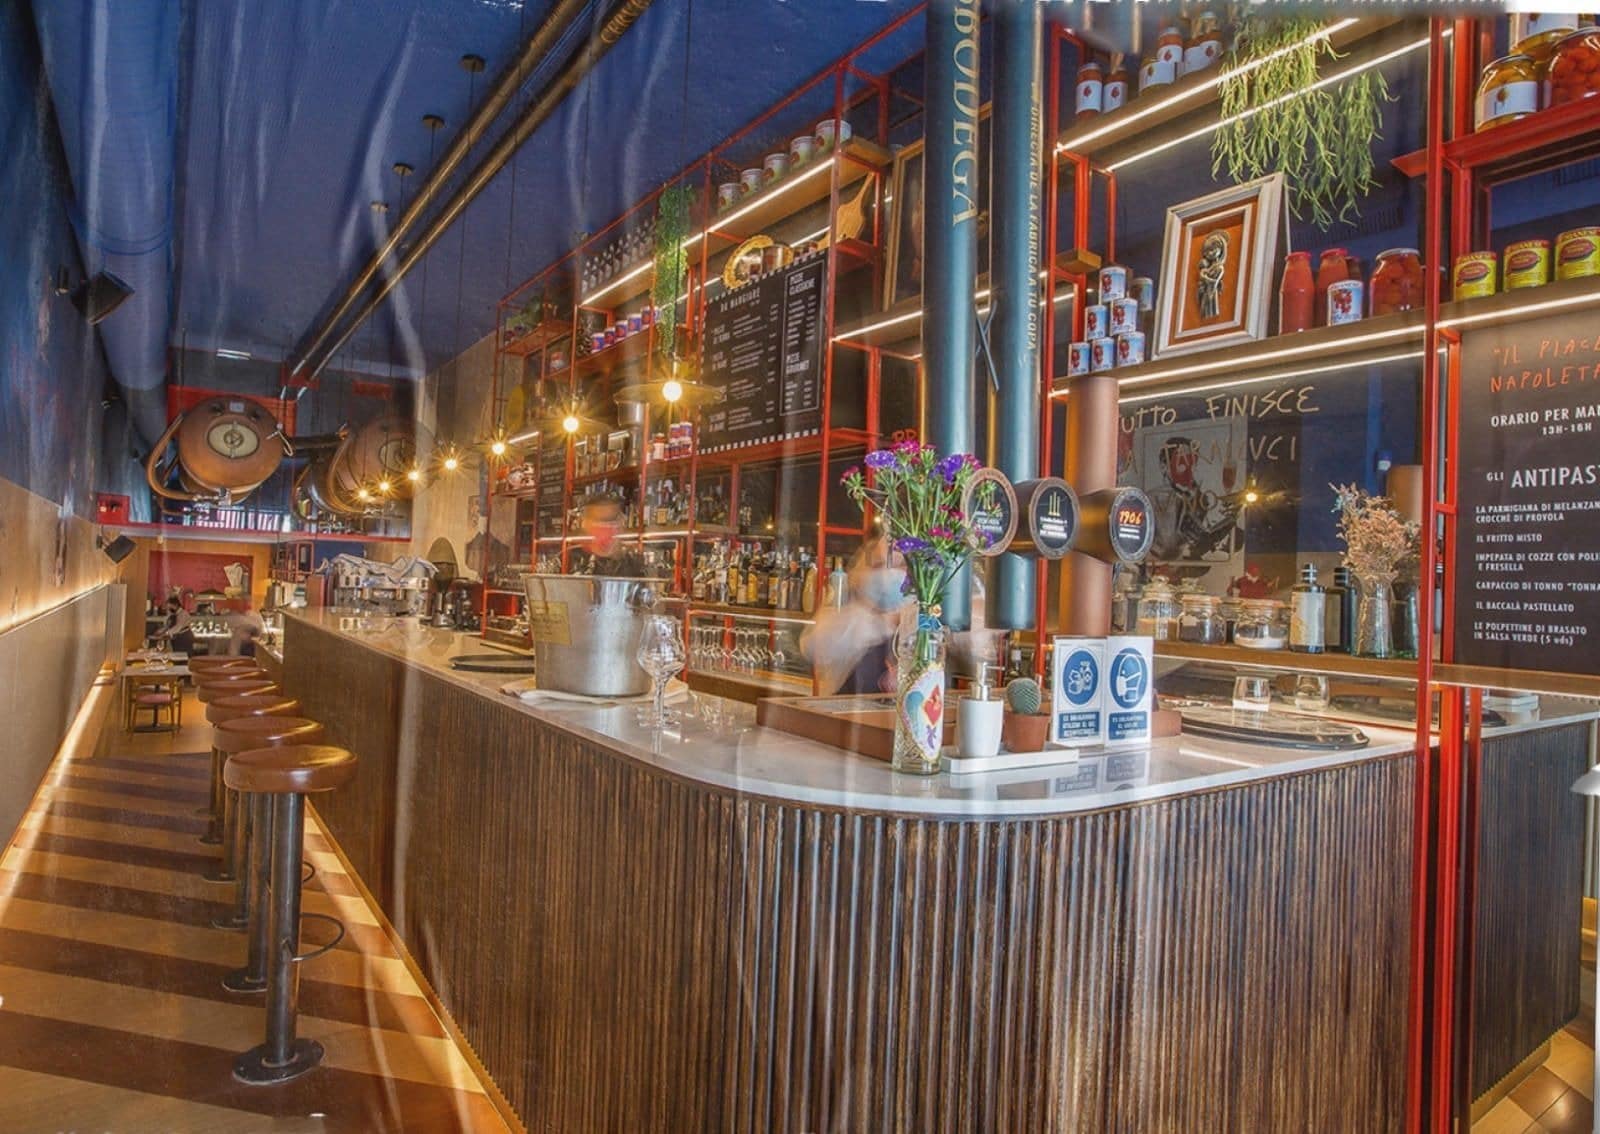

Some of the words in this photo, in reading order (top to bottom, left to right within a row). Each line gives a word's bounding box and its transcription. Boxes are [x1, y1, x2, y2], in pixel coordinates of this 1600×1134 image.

[952, 0, 979, 226] BODEGA
[1029, 194, 1038, 210] LA
[1028, 214, 1039, 273] FABRICA
[1028, 277, 1037, 286] A
[1028, 290, 1037, 308] TU
[1027, 312, 1037, 350] COPA
[1119, 405, 1177, 433] UTTO
[1206, 386, 1320, 422] FINISCE
[1491, 411, 1539, 427] ORARIO
[1545, 408, 1569, 422] PER
[1486, 472, 1504, 481] GLI
[1511, 464, 1600, 489] ANTIPAS
[1475, 505, 1486, 513] LA
[1488, 504, 1538, 513] PARMIGIANA
[1541, 503, 1551, 511] DI
[1119, 509, 1143, 525] 1906
[1513, 514, 1524, 522] DI
[1526, 512, 1565, 522] PROVOLA
[1476, 534, 1484, 543] IL
[1486, 534, 1514, 543] FRITTO
[1516, 533, 1543, 542] MISTO
[1475, 553, 1514, 561] IMPEPATA
[1516, 553, 1525, 561] DI
[1528, 552, 1554, 561] COZZE
[1557, 552, 1575, 561] CON
[1485, 562, 1524, 571] FRESELLA
[1475, 581, 1520, 590] CARPACCIO
[1522, 582, 1532, 590] DI
[1534, 582, 1563, 591] TONNO
[1523, 602, 1575, 613] PASTELLATO
[1474, 622, 1483, 630] LE
[1485, 622, 1533, 632] POLPETTINE
[1535, 624, 1546, 633] DI
[1548, 624, 1588, 636] BRASATO
[1474, 631, 1483, 640] IN
[1485, 631, 1511, 641] SALSA
[1512, 633, 1538, 643] VERDE
